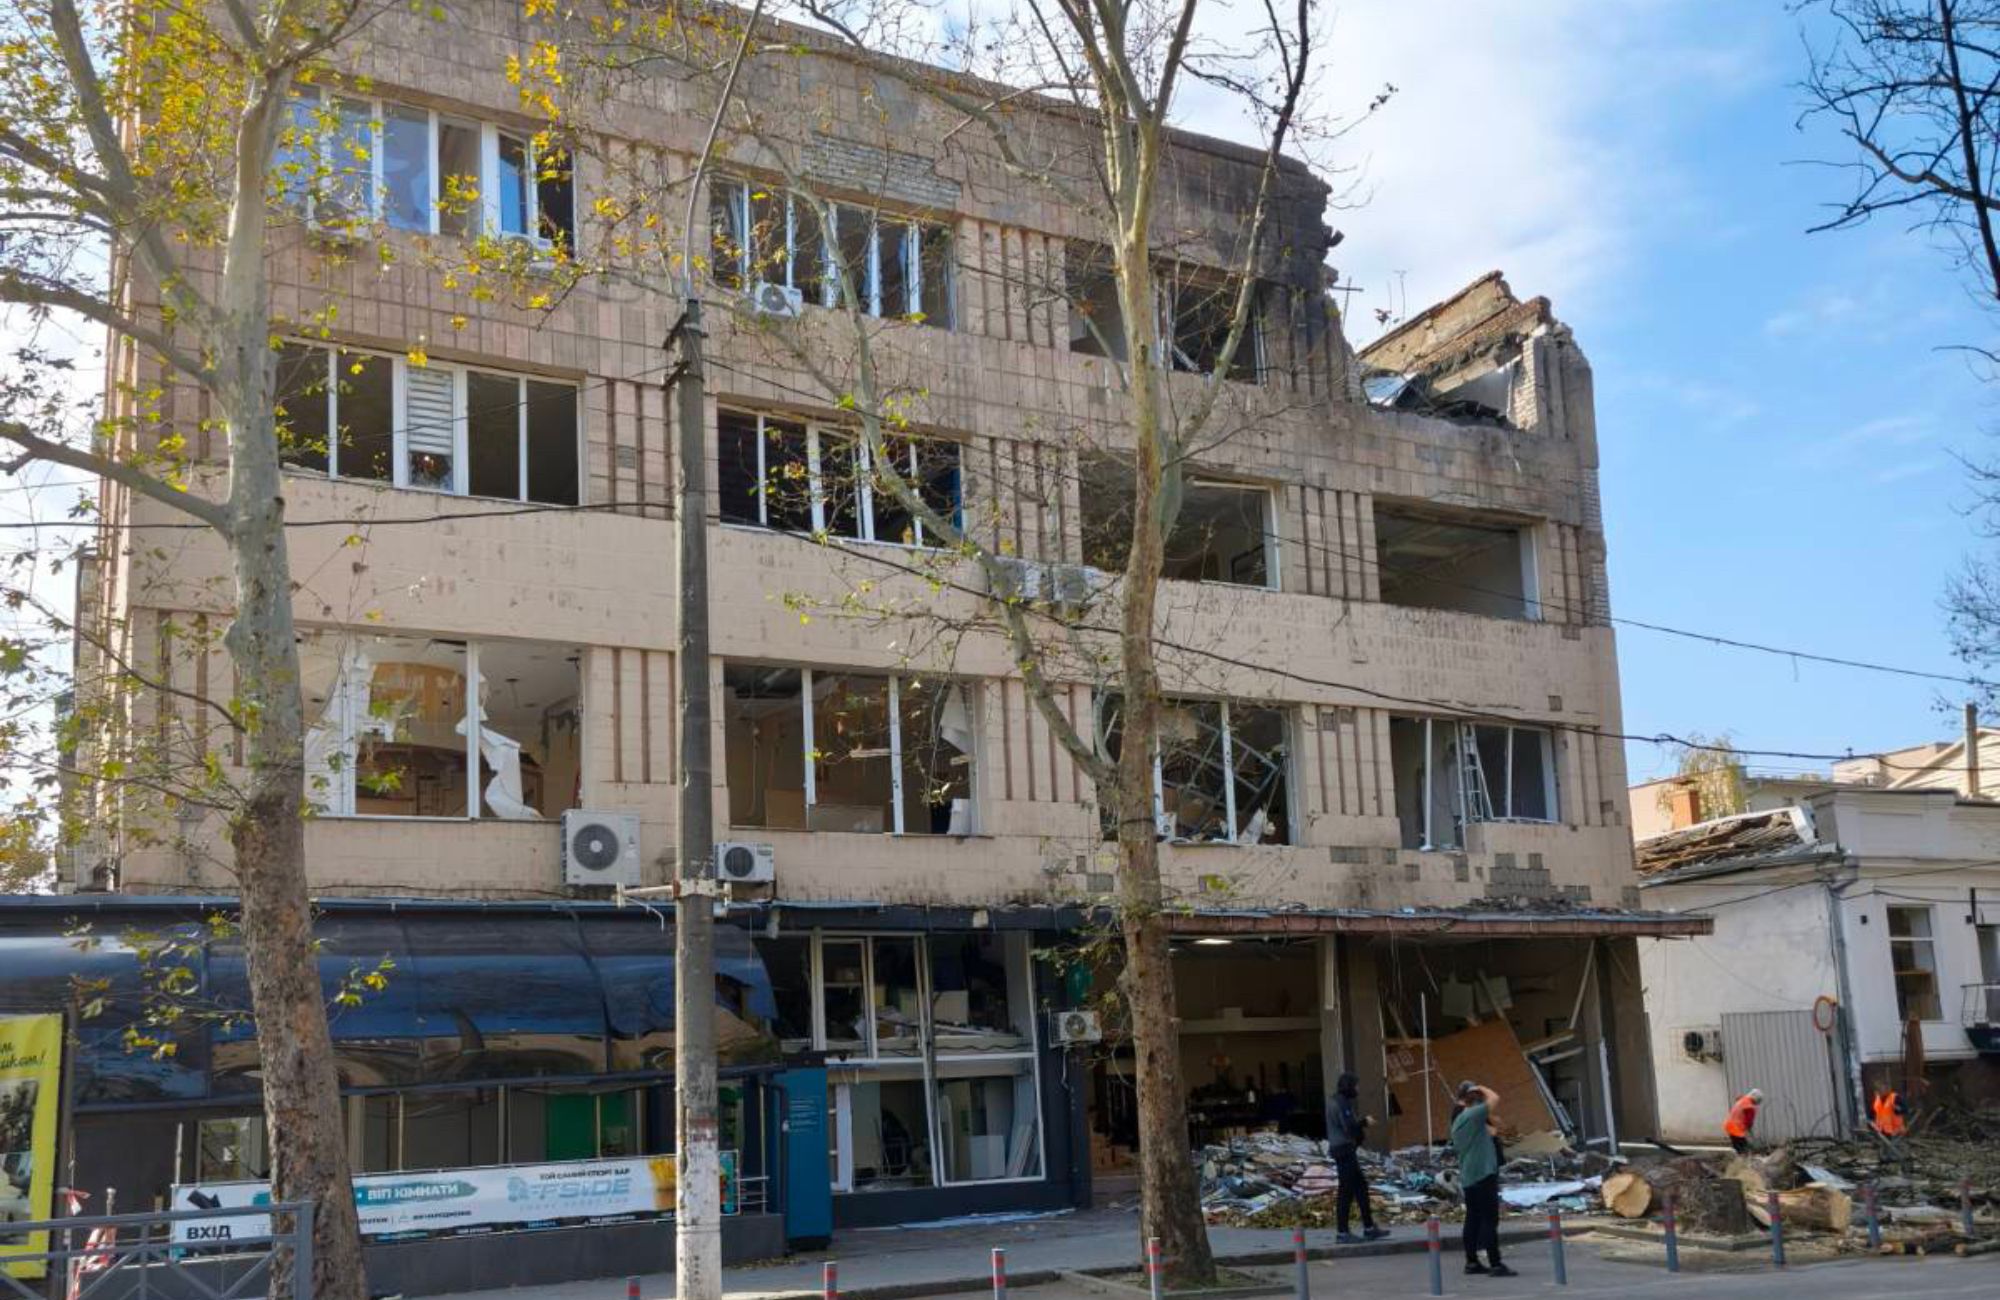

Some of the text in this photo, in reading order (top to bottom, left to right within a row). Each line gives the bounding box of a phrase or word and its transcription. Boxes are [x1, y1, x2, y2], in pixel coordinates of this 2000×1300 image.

[367, 1184, 459, 1200] ВІП КІМНАТИ
[186, 1224, 232, 1241] ВХІД
